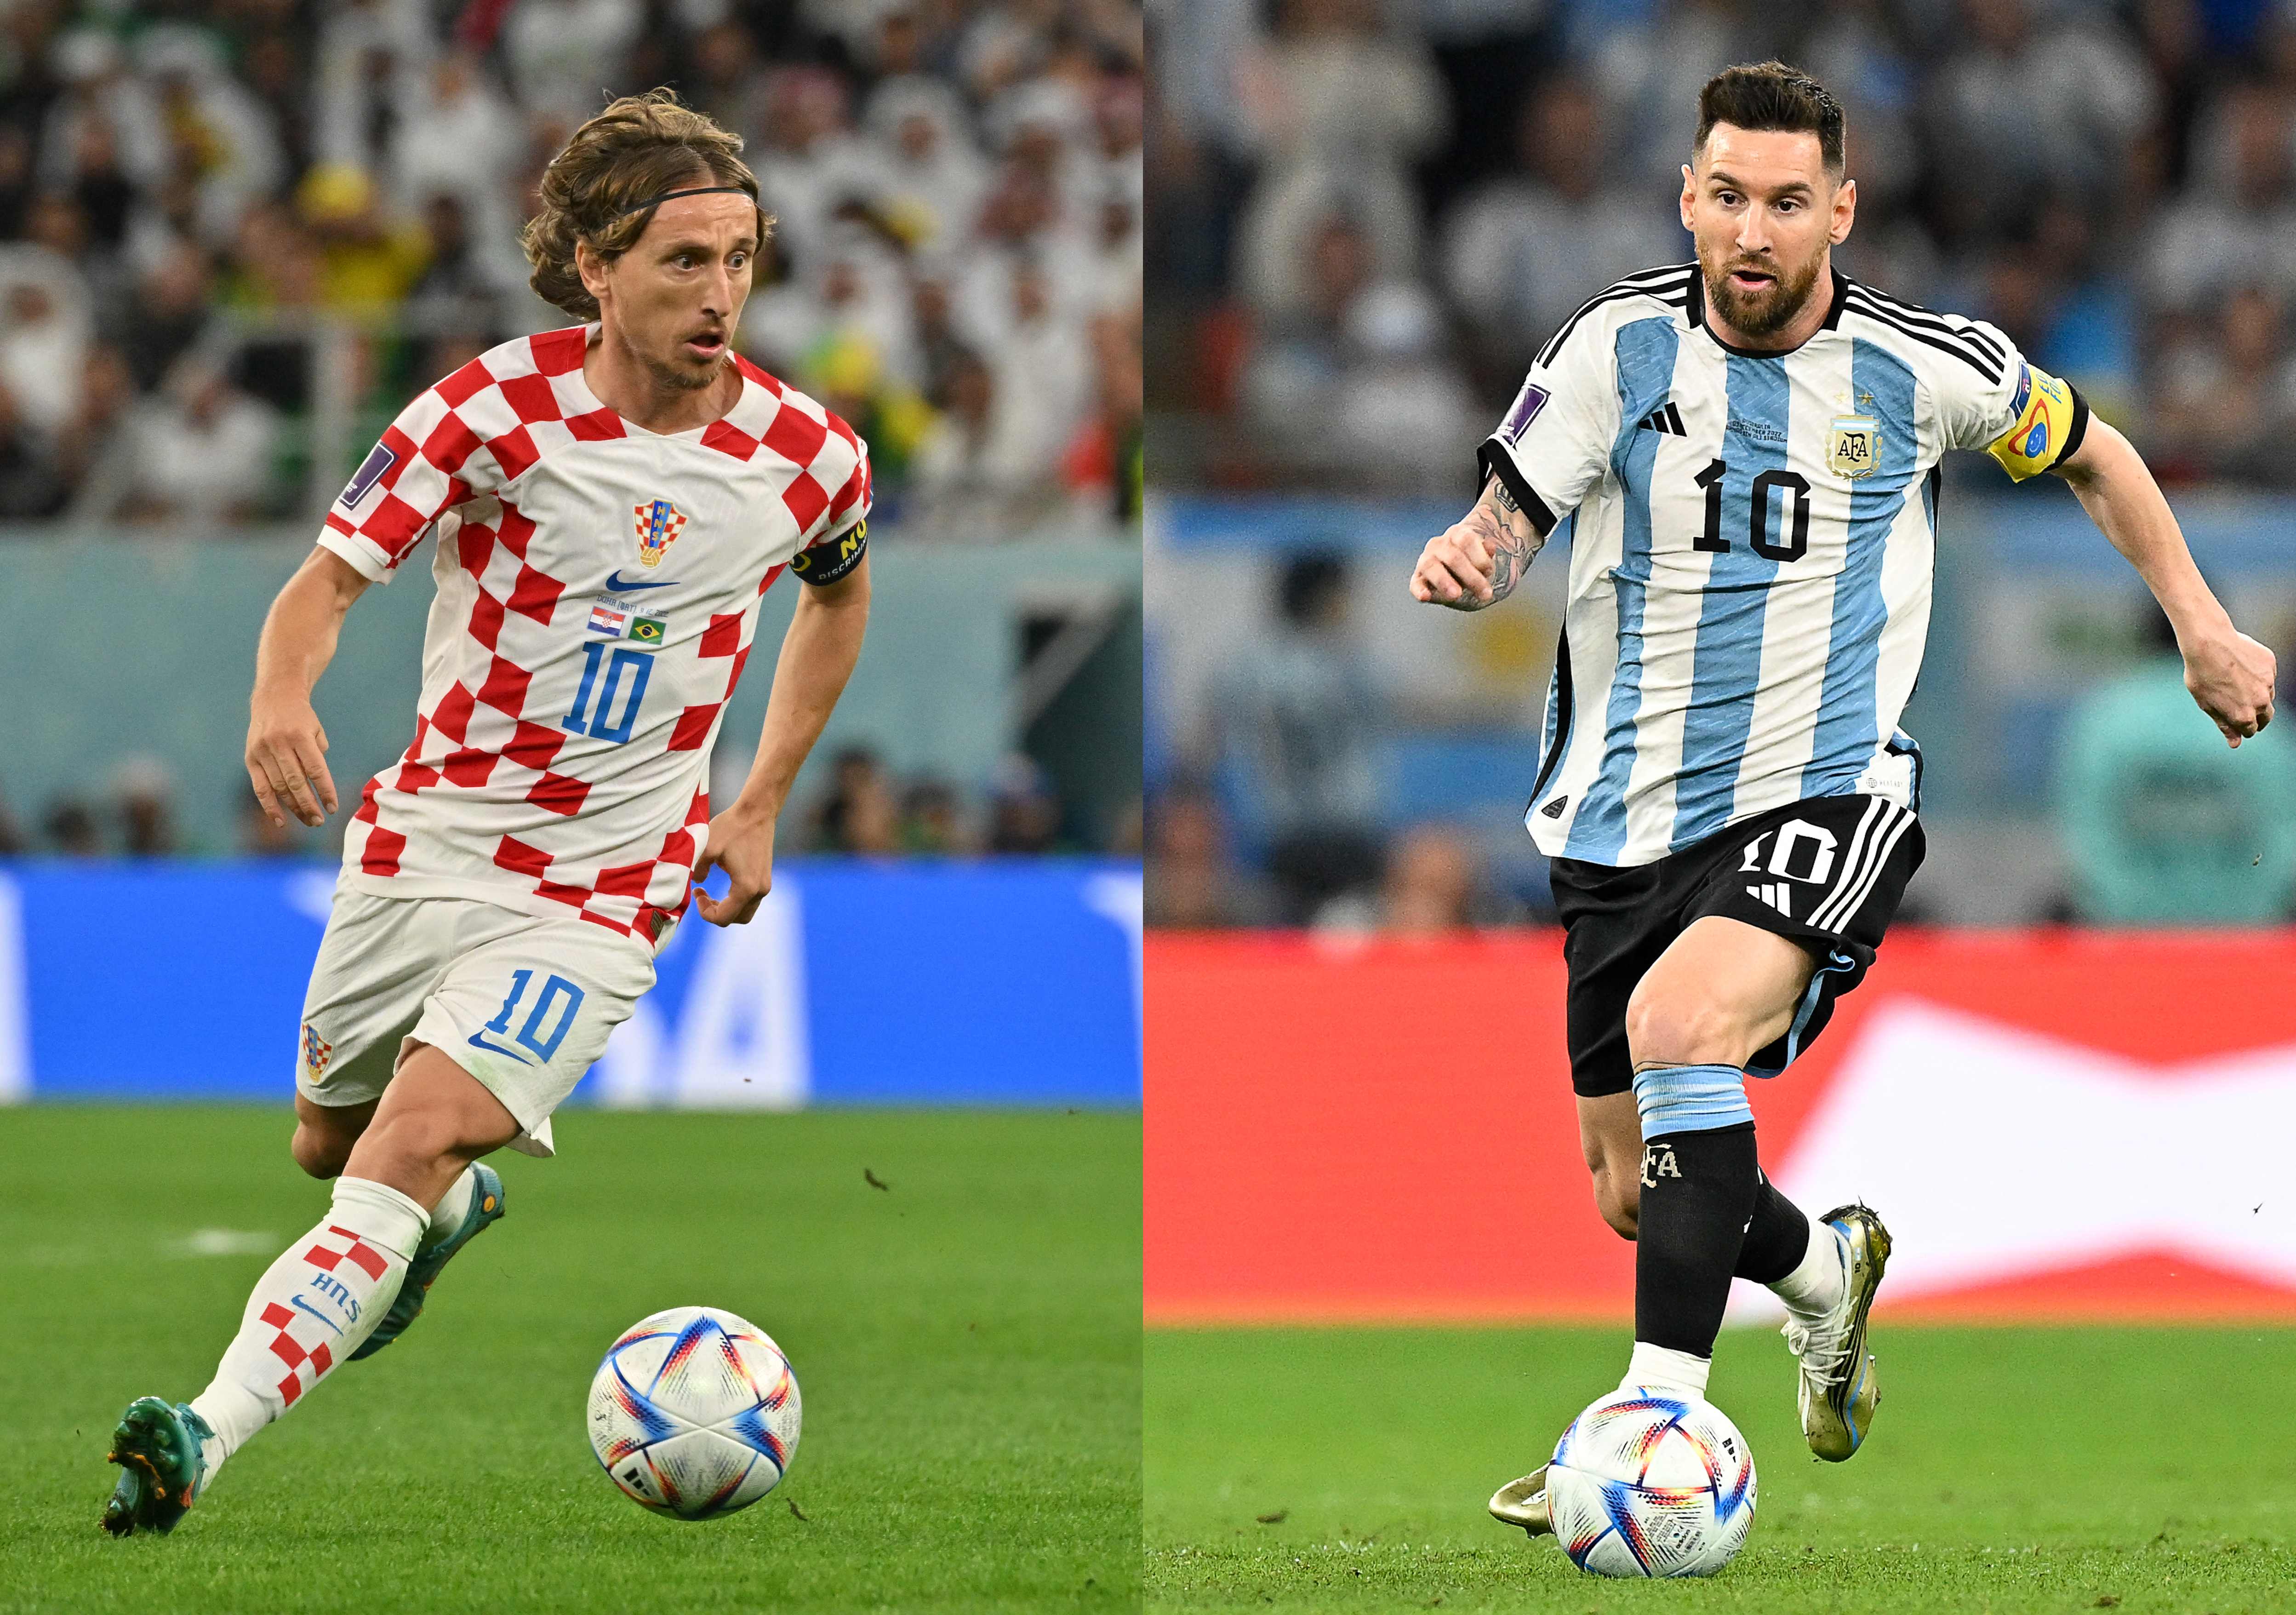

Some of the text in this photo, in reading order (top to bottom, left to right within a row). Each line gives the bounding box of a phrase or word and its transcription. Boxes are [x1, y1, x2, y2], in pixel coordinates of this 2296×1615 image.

[1838, 433, 1868, 462] AFA
[1693, 458, 1811, 562] 10
[818, 531, 868, 579] DISCRIMIN
[840, 519, 867, 560] NO
[561, 641, 655, 744] 10
[1737, 818, 1838, 884] 10
[484, 969, 585, 1064] 10
[1640, 1143, 1683, 1188] FA
[1855, 1262, 1861, 1274] 10
